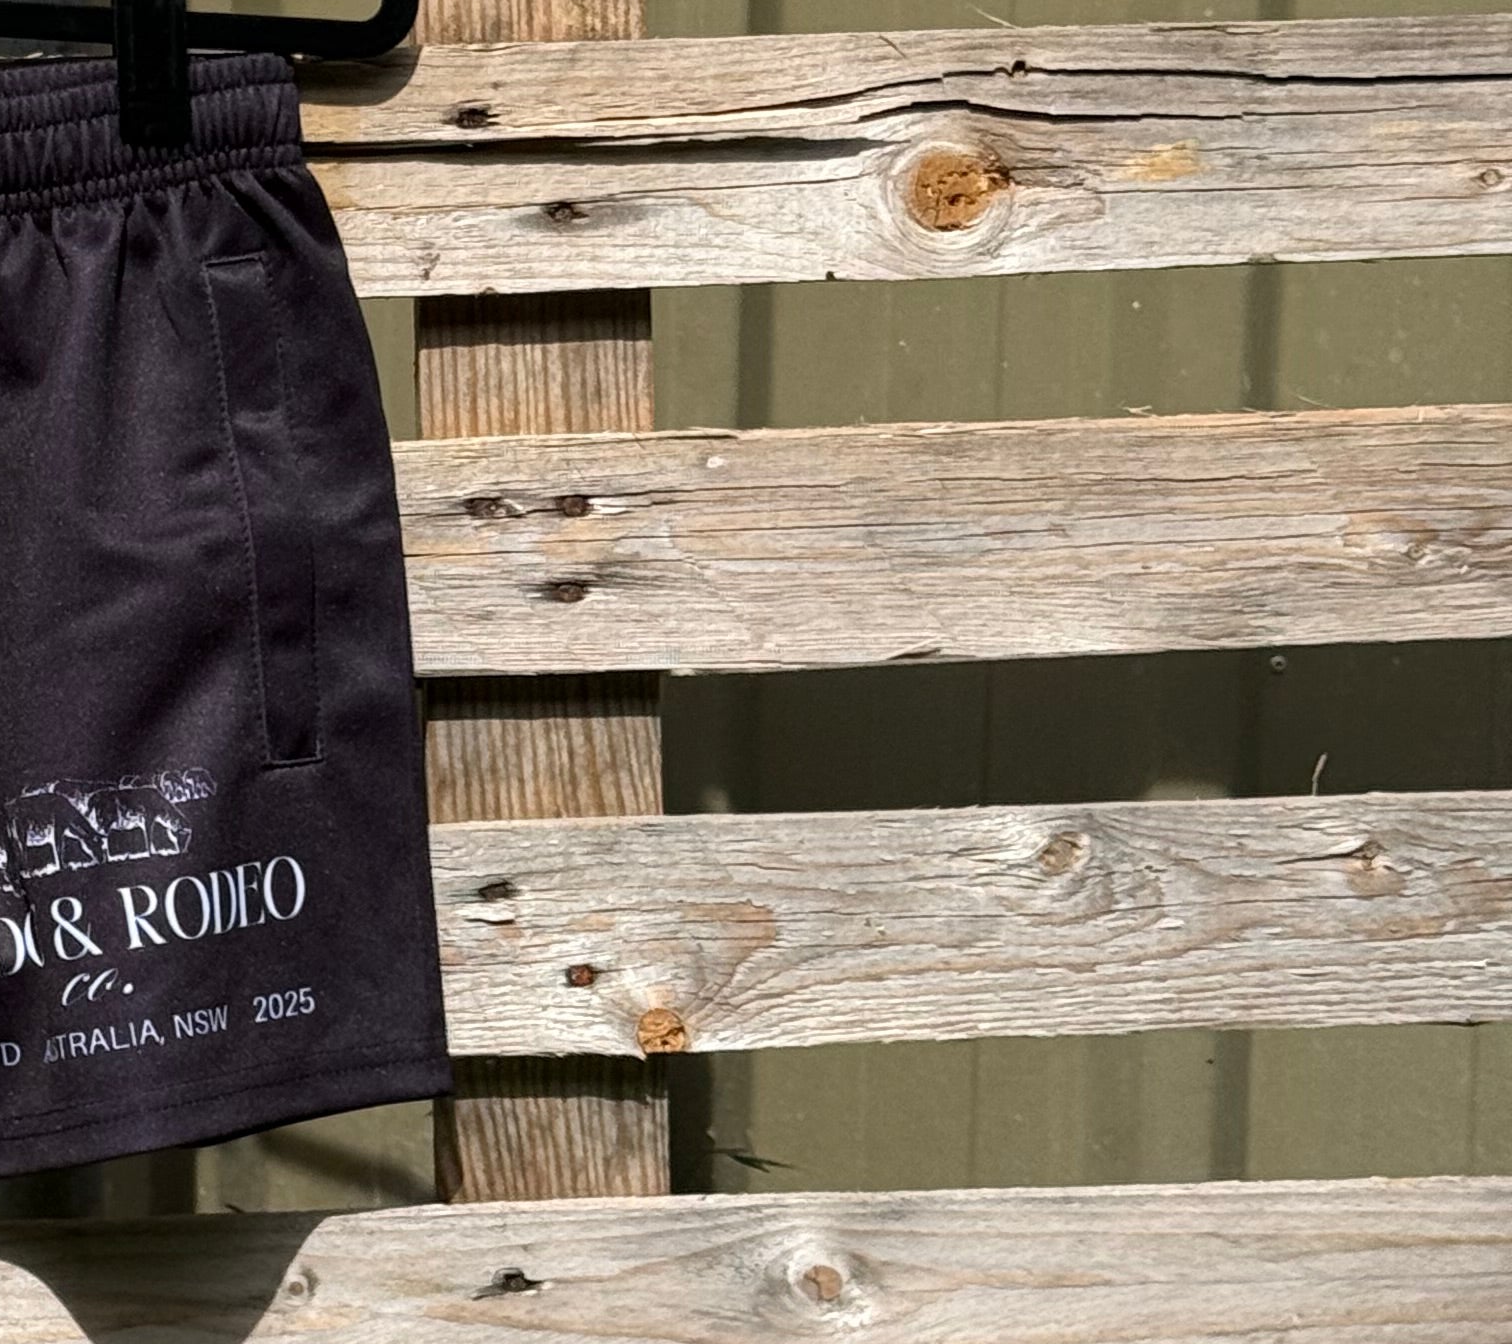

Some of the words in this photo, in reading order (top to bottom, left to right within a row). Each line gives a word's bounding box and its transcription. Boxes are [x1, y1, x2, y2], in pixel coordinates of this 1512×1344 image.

[50, 896, 104, 961] &
[116, 855, 306, 950] RODEO
[42, 1018, 165, 1064] TRALIA,
[172, 1005, 228, 1039] NSW
[252, 987, 316, 1023] 2025
